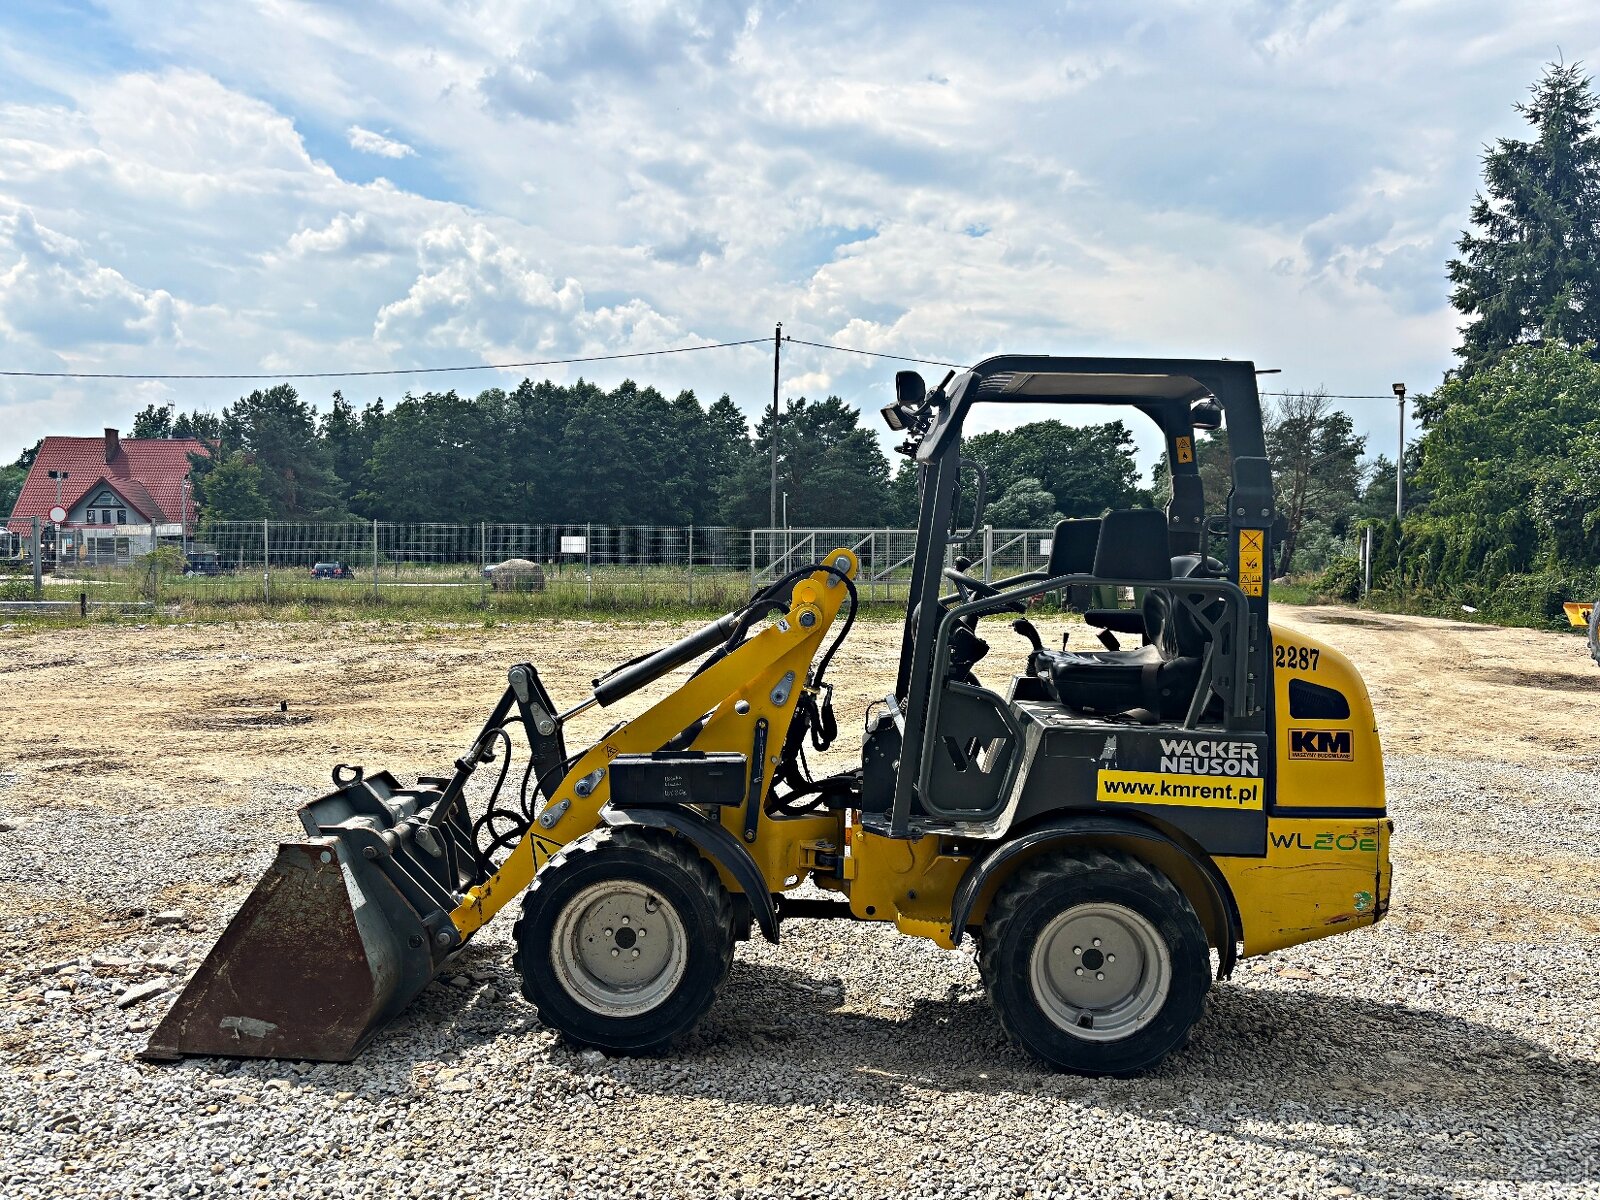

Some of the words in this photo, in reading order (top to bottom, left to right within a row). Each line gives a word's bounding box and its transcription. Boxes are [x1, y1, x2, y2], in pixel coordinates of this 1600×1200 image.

[1275, 645, 1320, 671] 2287
[1159, 738, 1259, 759] WACKER
[1291, 731, 1351, 753] KM
[1160, 756, 1259, 776] NEUSON
[1104, 779, 1258, 805] www.kmrent.pl
